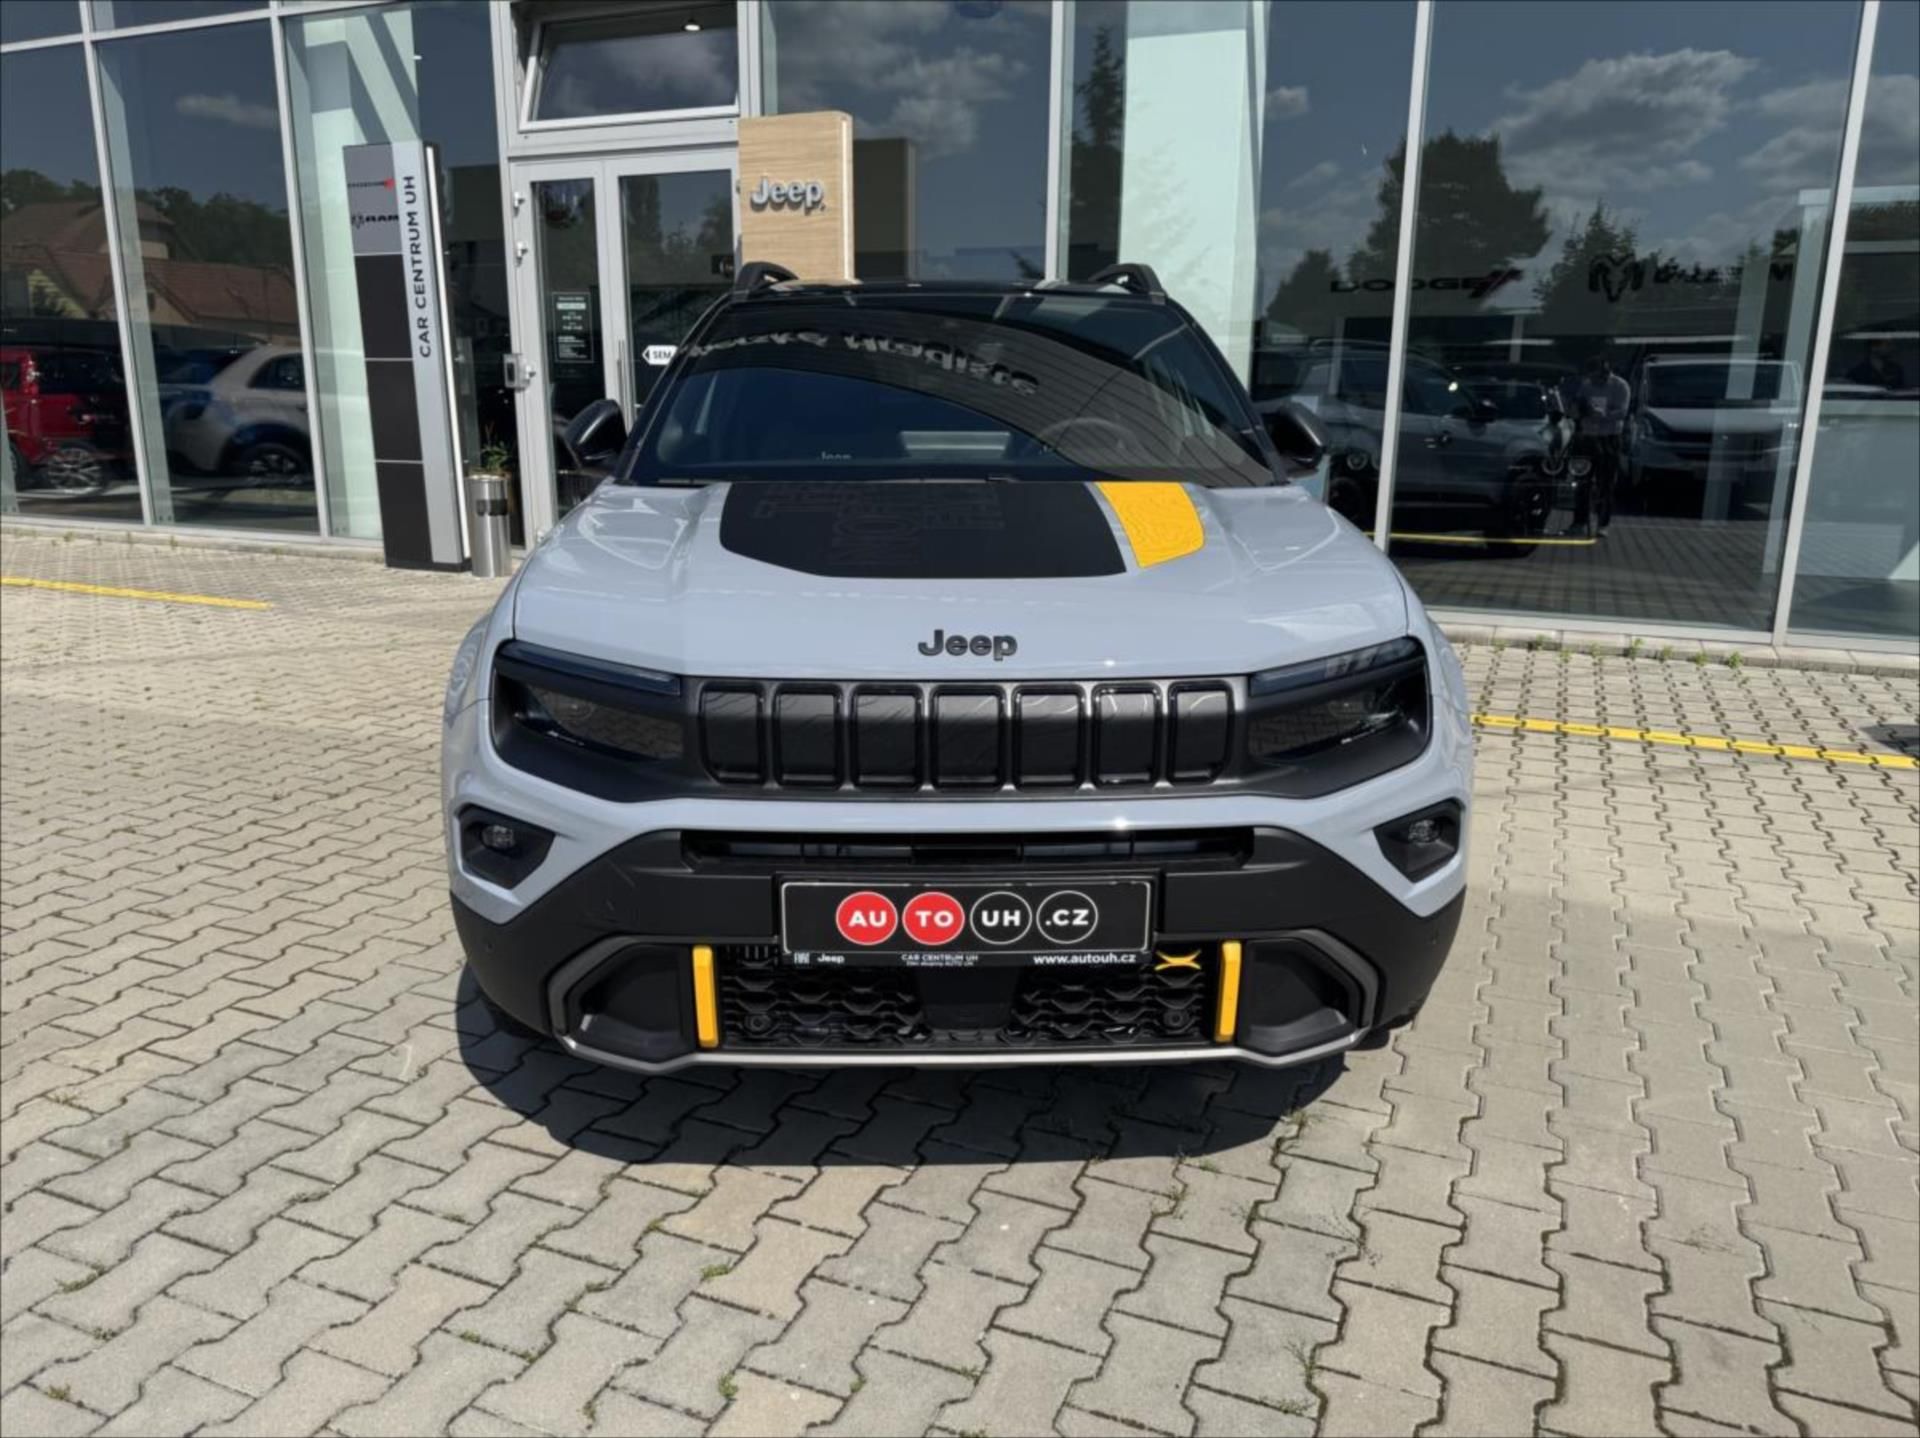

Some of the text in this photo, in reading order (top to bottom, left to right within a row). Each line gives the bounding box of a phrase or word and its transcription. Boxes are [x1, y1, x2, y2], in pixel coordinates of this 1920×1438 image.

[750, 176, 824, 212] Jeep
[402, 175, 432, 358] CAR CENTRUM UH
[918, 629, 1018, 662] Jeep
[848, 909, 1090, 927] AU TO UH .CZ
[817, 952, 845, 964] Jeep
[1033, 952, 1137, 965] www.autouh.cz
